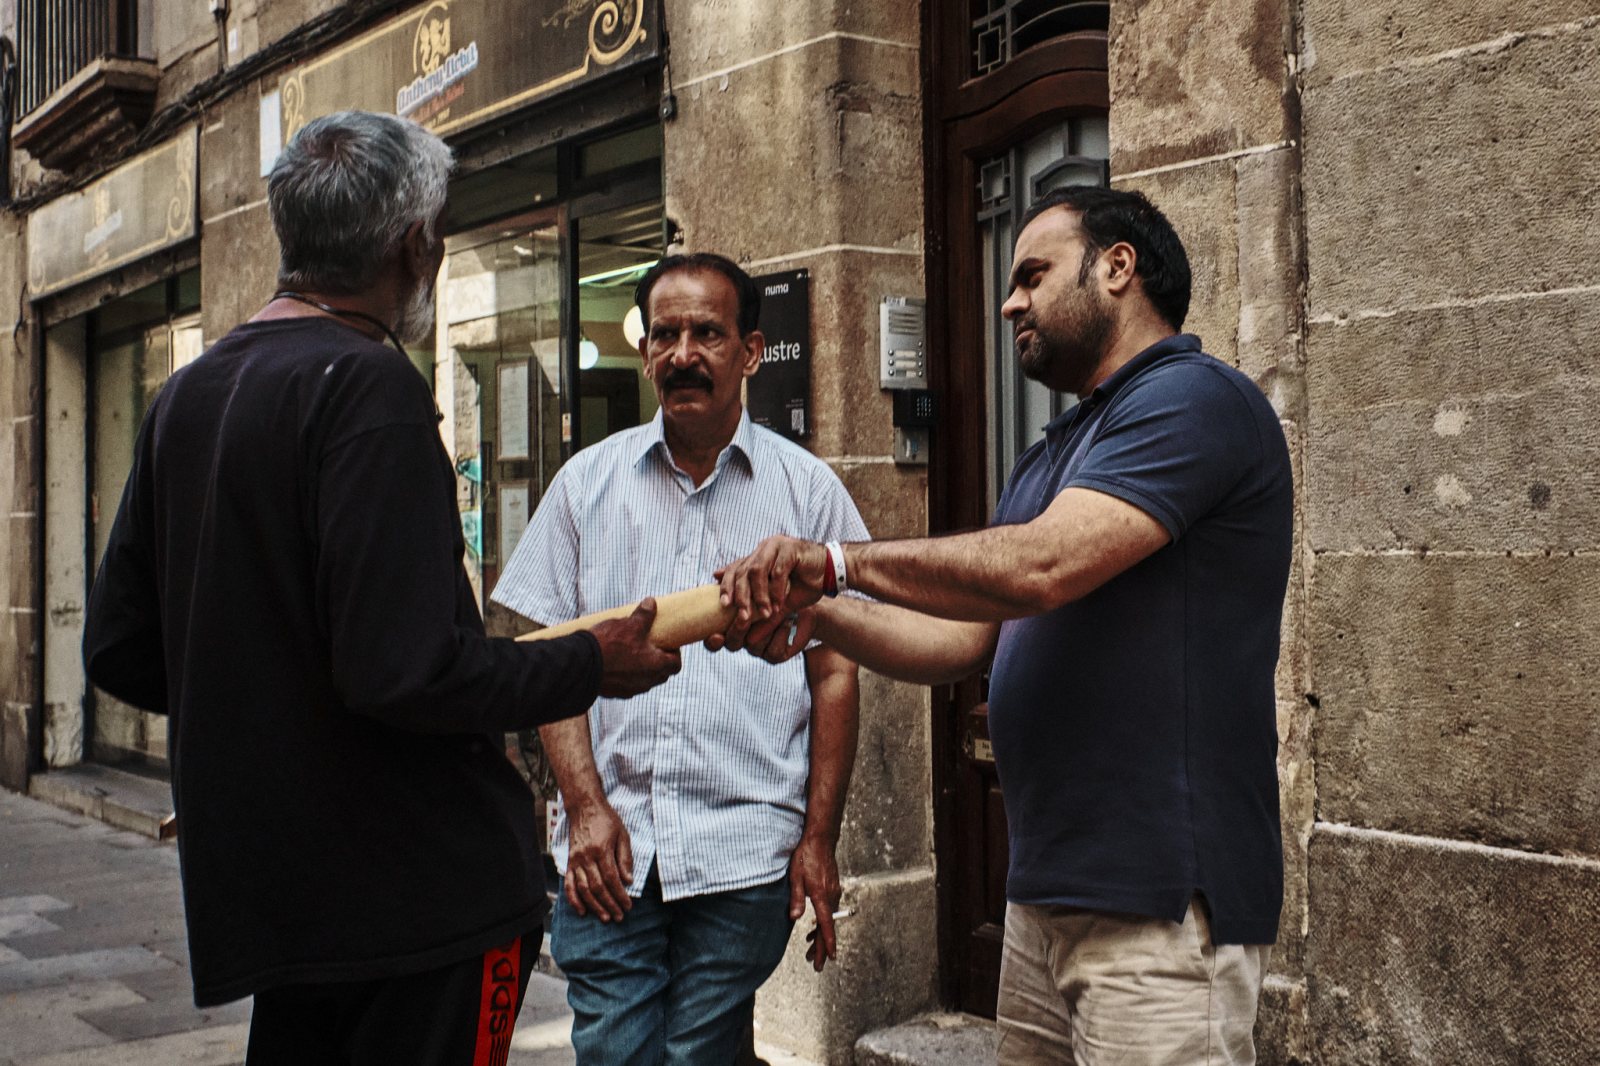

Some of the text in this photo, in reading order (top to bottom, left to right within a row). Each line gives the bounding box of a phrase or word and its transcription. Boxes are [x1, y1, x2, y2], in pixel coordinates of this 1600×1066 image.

[398, 65, 444, 113] Anthony
[765, 283, 789, 296] numa
[761, 340, 800, 363] ustre
[489, 957, 516, 1035] das
